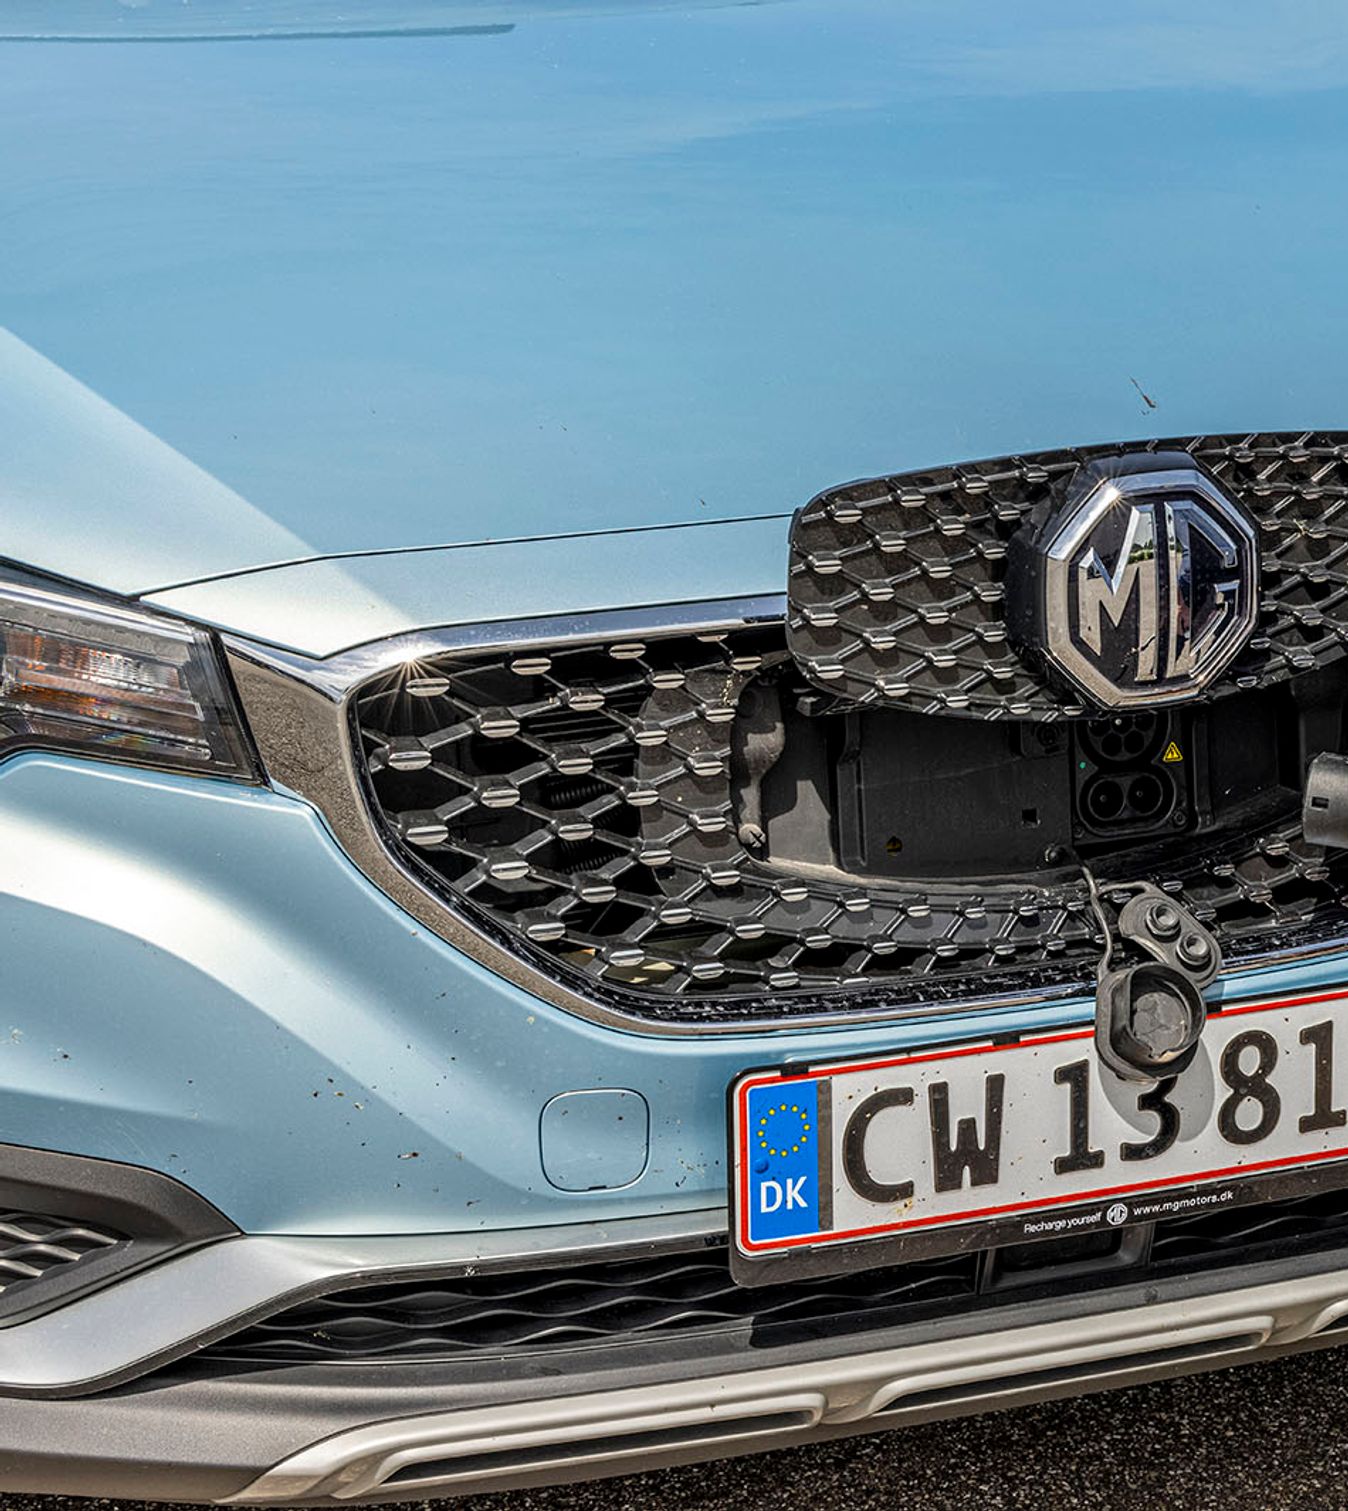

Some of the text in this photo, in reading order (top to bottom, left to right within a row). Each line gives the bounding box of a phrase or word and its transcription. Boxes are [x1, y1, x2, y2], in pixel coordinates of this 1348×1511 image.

[1079, 500, 1240, 682] MG
[842, 1073, 1005, 1203] CW
[1053, 1058, 1182, 1176] 13
[759, 1176, 809, 1214] DK
[1024, 1219, 1067, 1233] Recharge
[1066, 1211, 1102, 1227] yourself
[1133, 1190, 1234, 1216] www.mgmotors.dk
